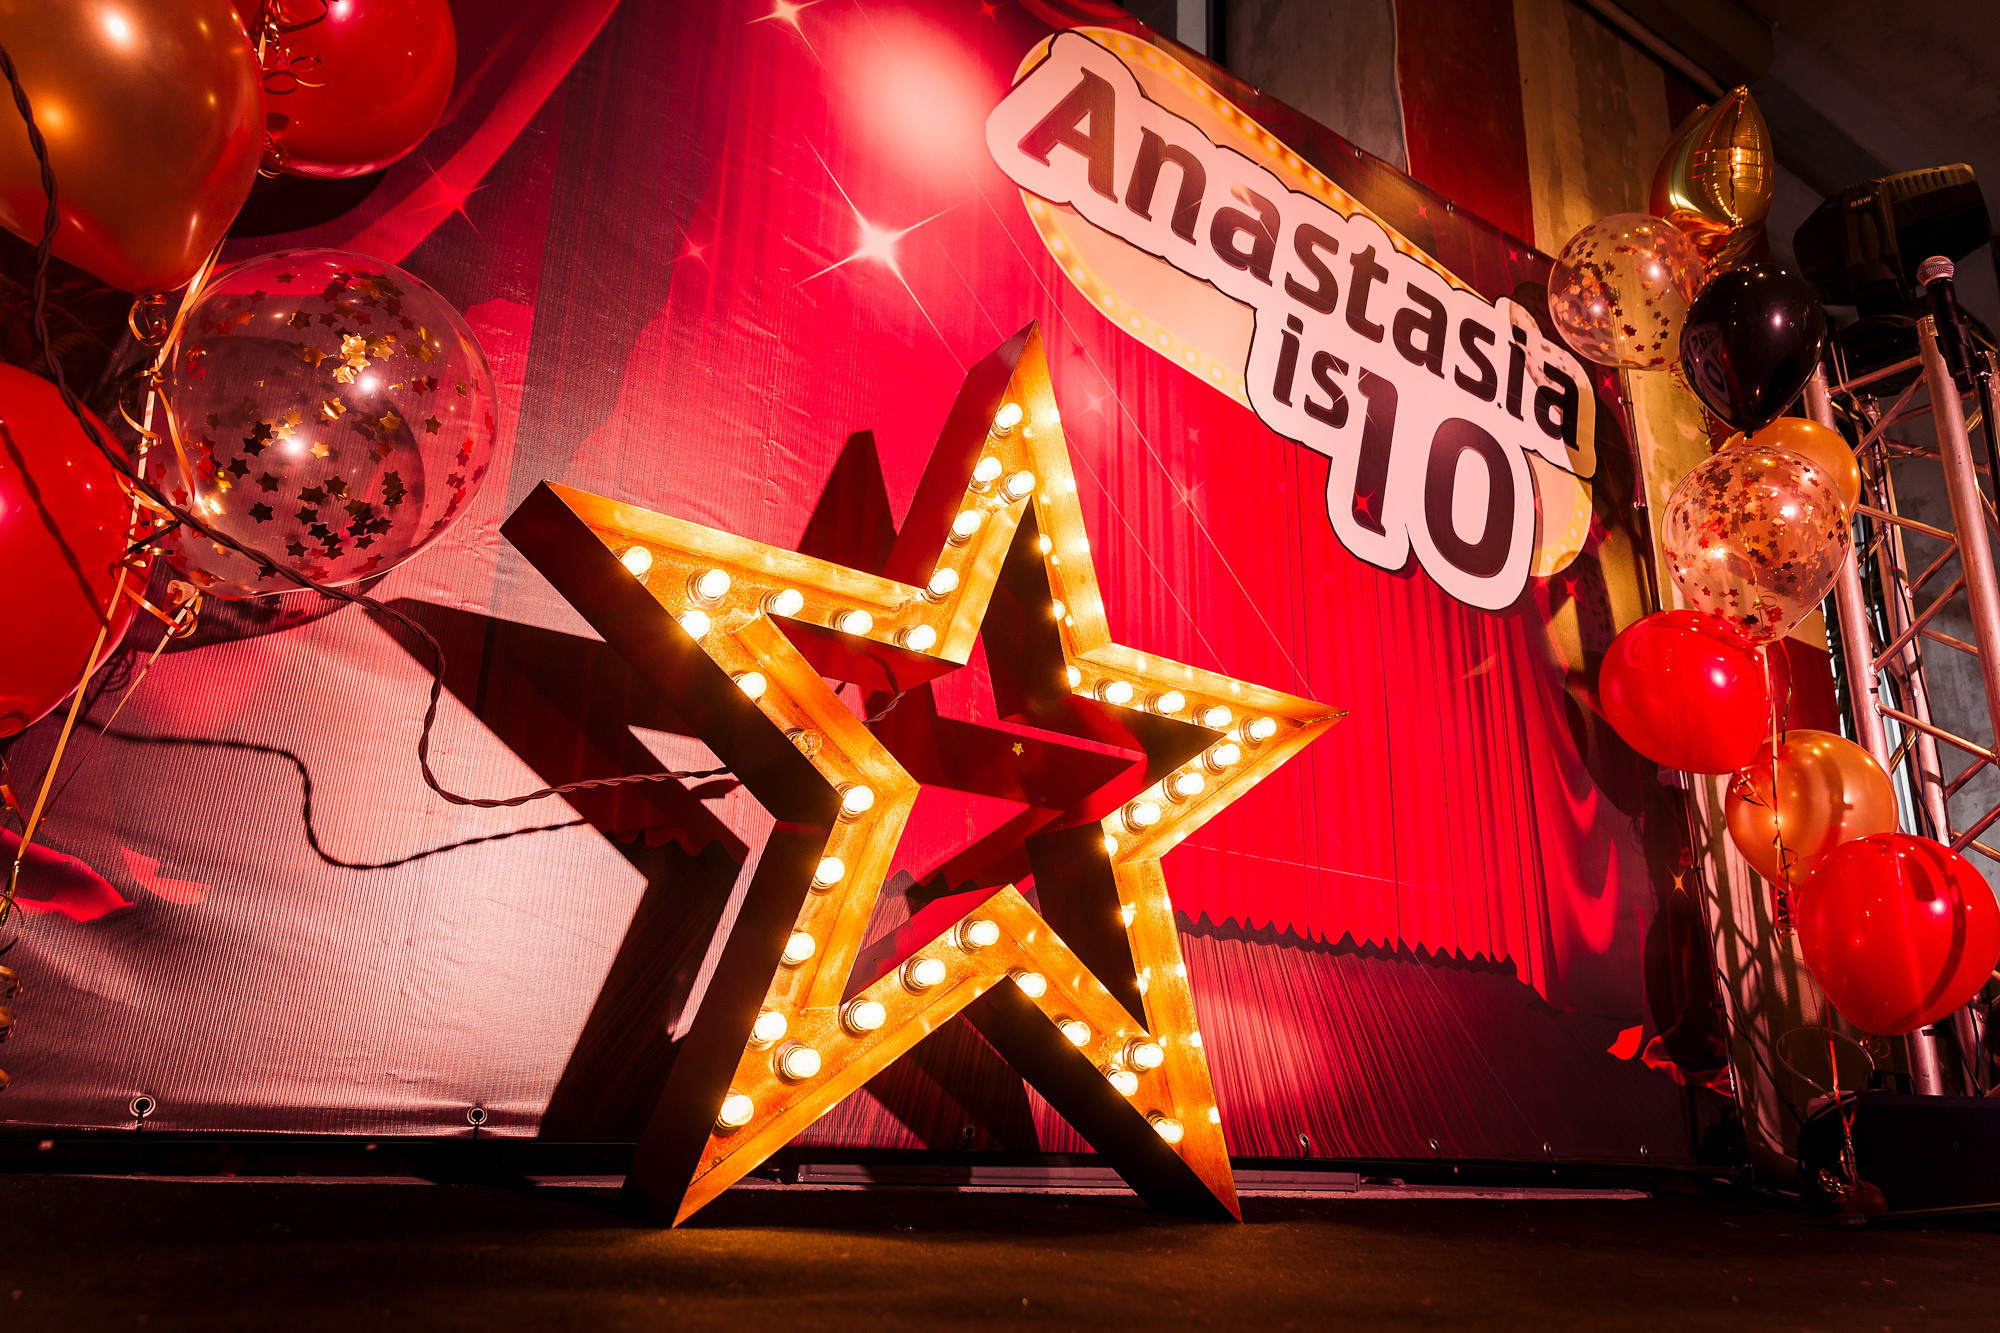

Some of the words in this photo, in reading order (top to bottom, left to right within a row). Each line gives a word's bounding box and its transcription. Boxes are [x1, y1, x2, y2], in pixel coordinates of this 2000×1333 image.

[1018, 66, 1580, 452] Anastasia
[1272, 312, 1350, 430] is
[1351, 366, 1516, 579] 10
